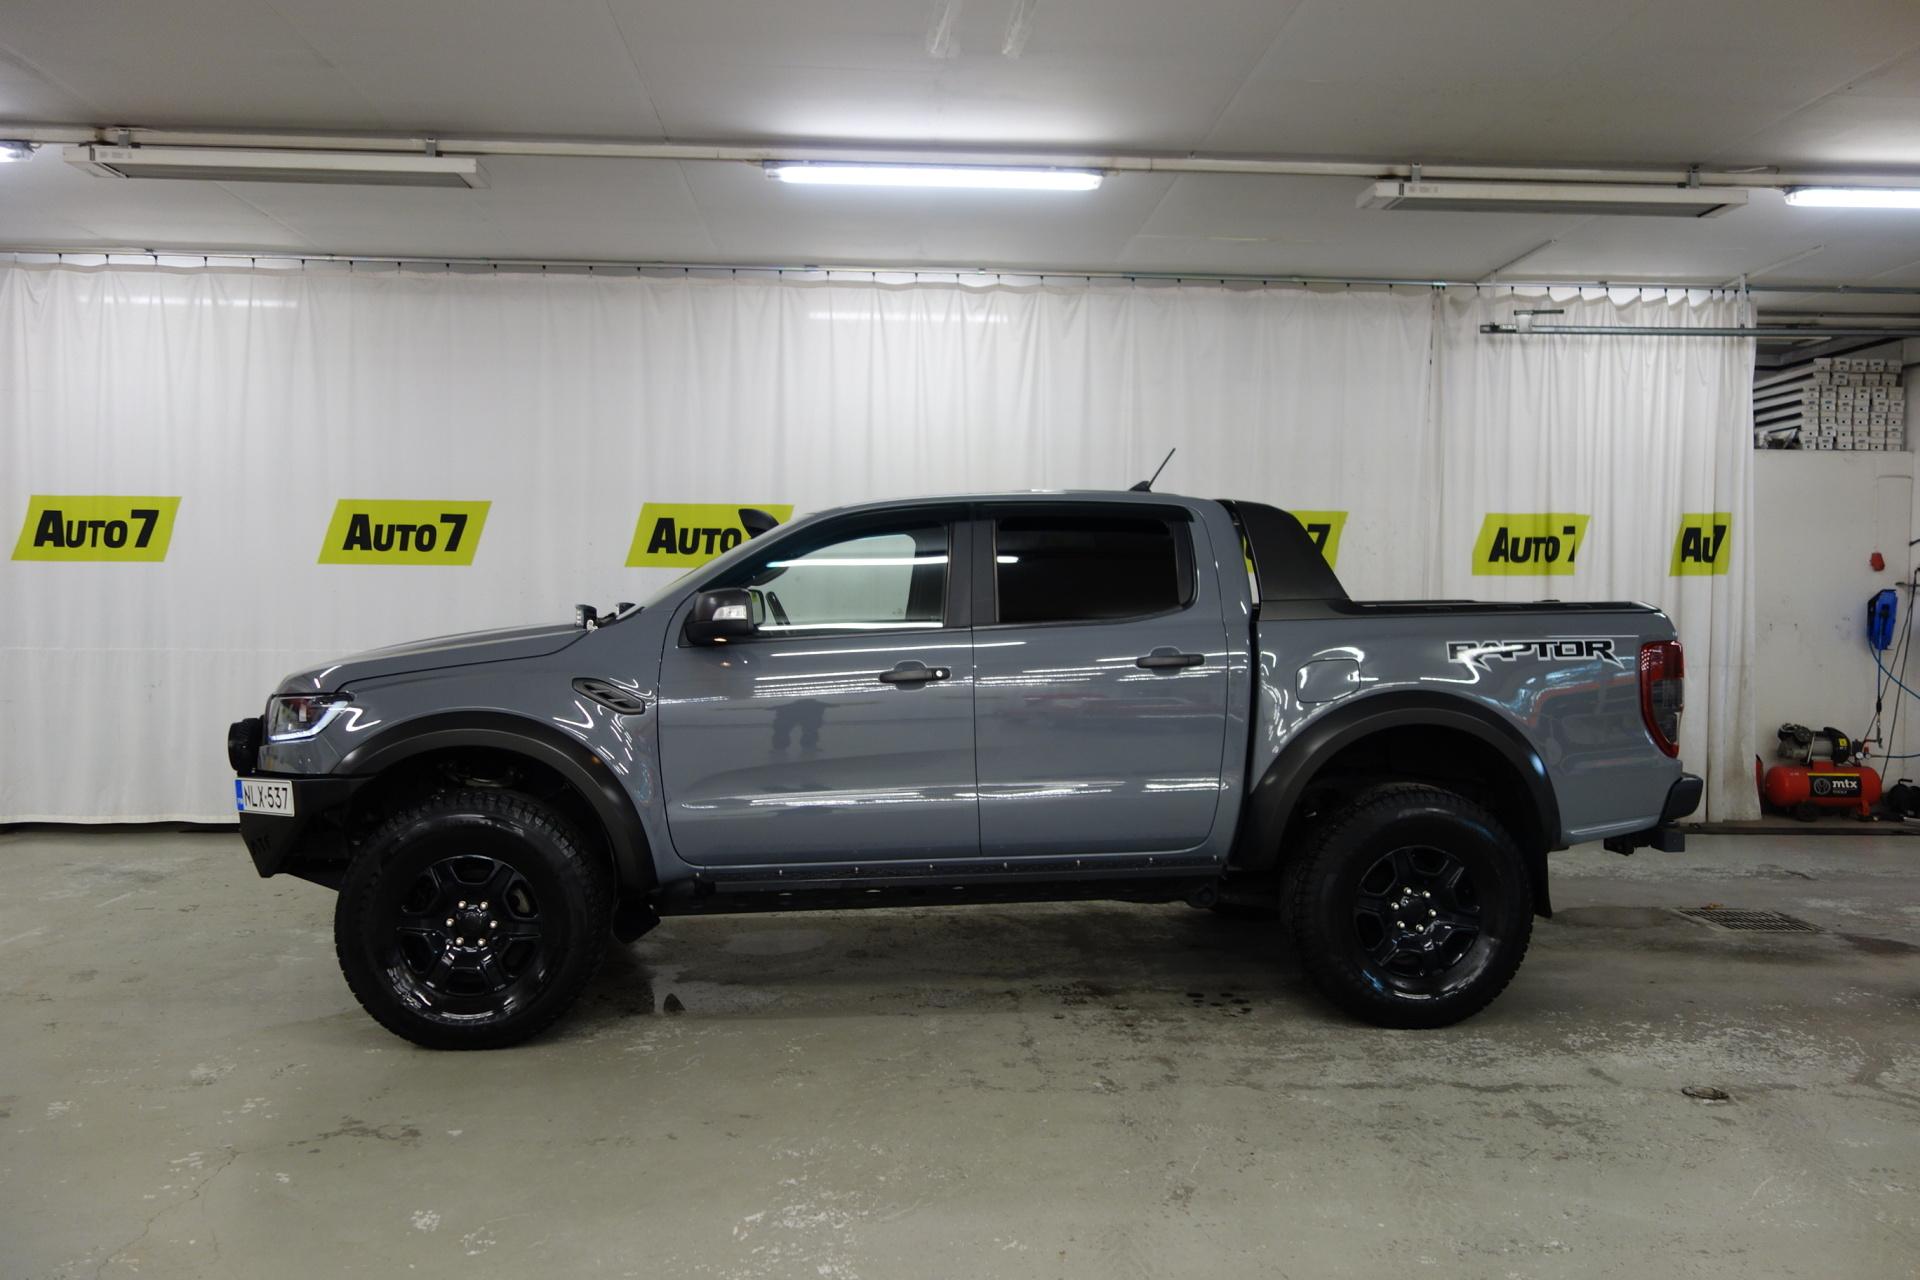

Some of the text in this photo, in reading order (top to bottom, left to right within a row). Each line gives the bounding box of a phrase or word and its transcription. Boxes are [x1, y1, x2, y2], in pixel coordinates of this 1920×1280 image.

[647, 517, 742, 555] AUTO
[1447, 639, 1625, 671] RAPTOR
[244, 785, 288, 809] NLX-537
[1832, 779, 1857, 788] mtx
